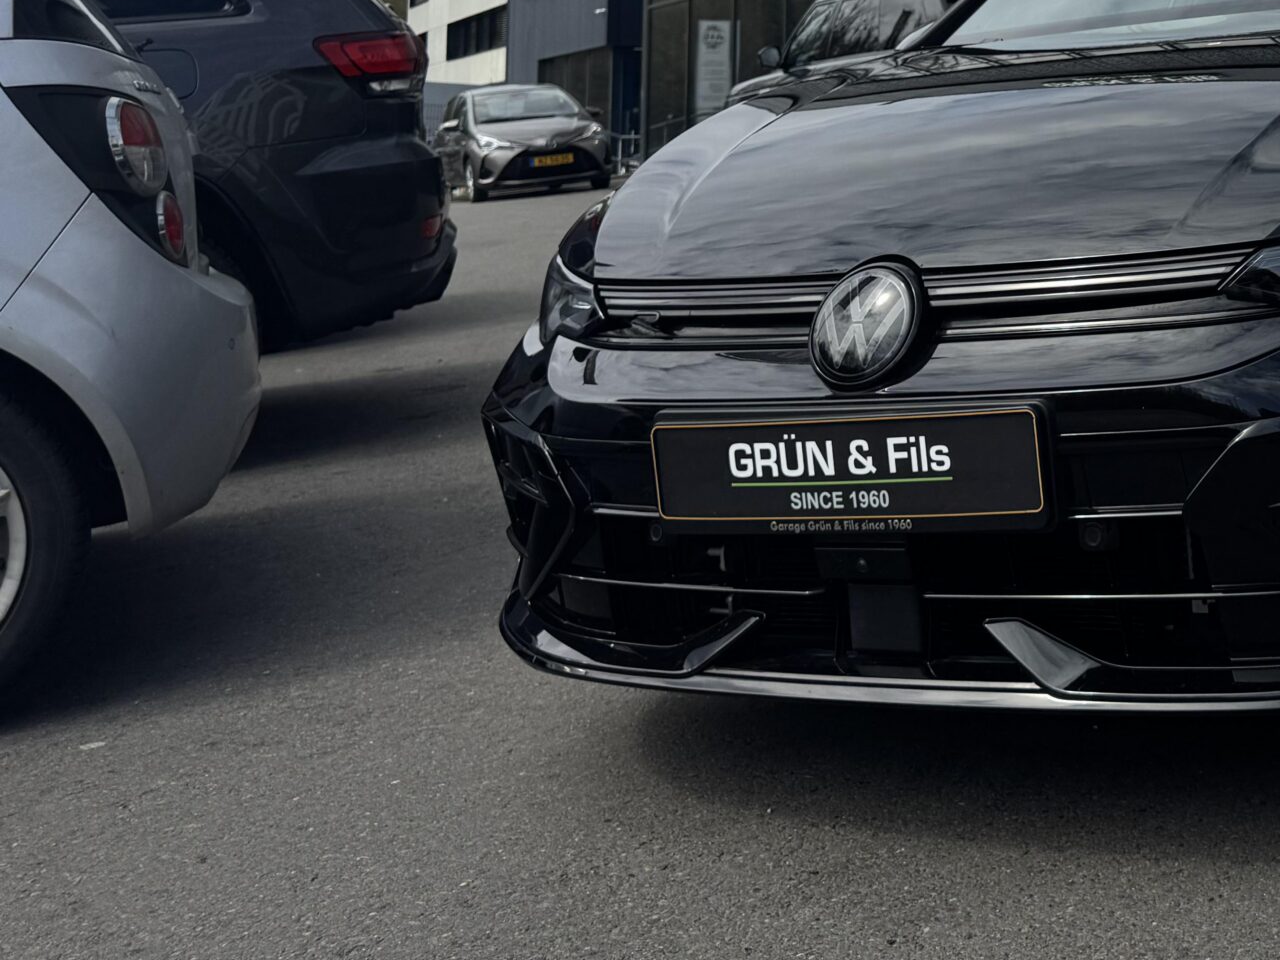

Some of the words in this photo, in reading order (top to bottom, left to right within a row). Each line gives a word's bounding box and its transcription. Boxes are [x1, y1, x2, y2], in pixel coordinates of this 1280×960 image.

[728, 434, 836, 479] GRÜN
[847, 439, 877, 474] &
[886, 435, 952, 475] Fils
[790, 491, 845, 511] SINCE
[849, 490, 890, 509] 1960
[770, 521, 806, 534] Garage
[808, 521, 832, 531] Grün
[834, 521, 843, 531] &
[843, 520, 860, 531] Fils
[861, 520, 885, 531] since
[887, 519, 913, 530] 1960
